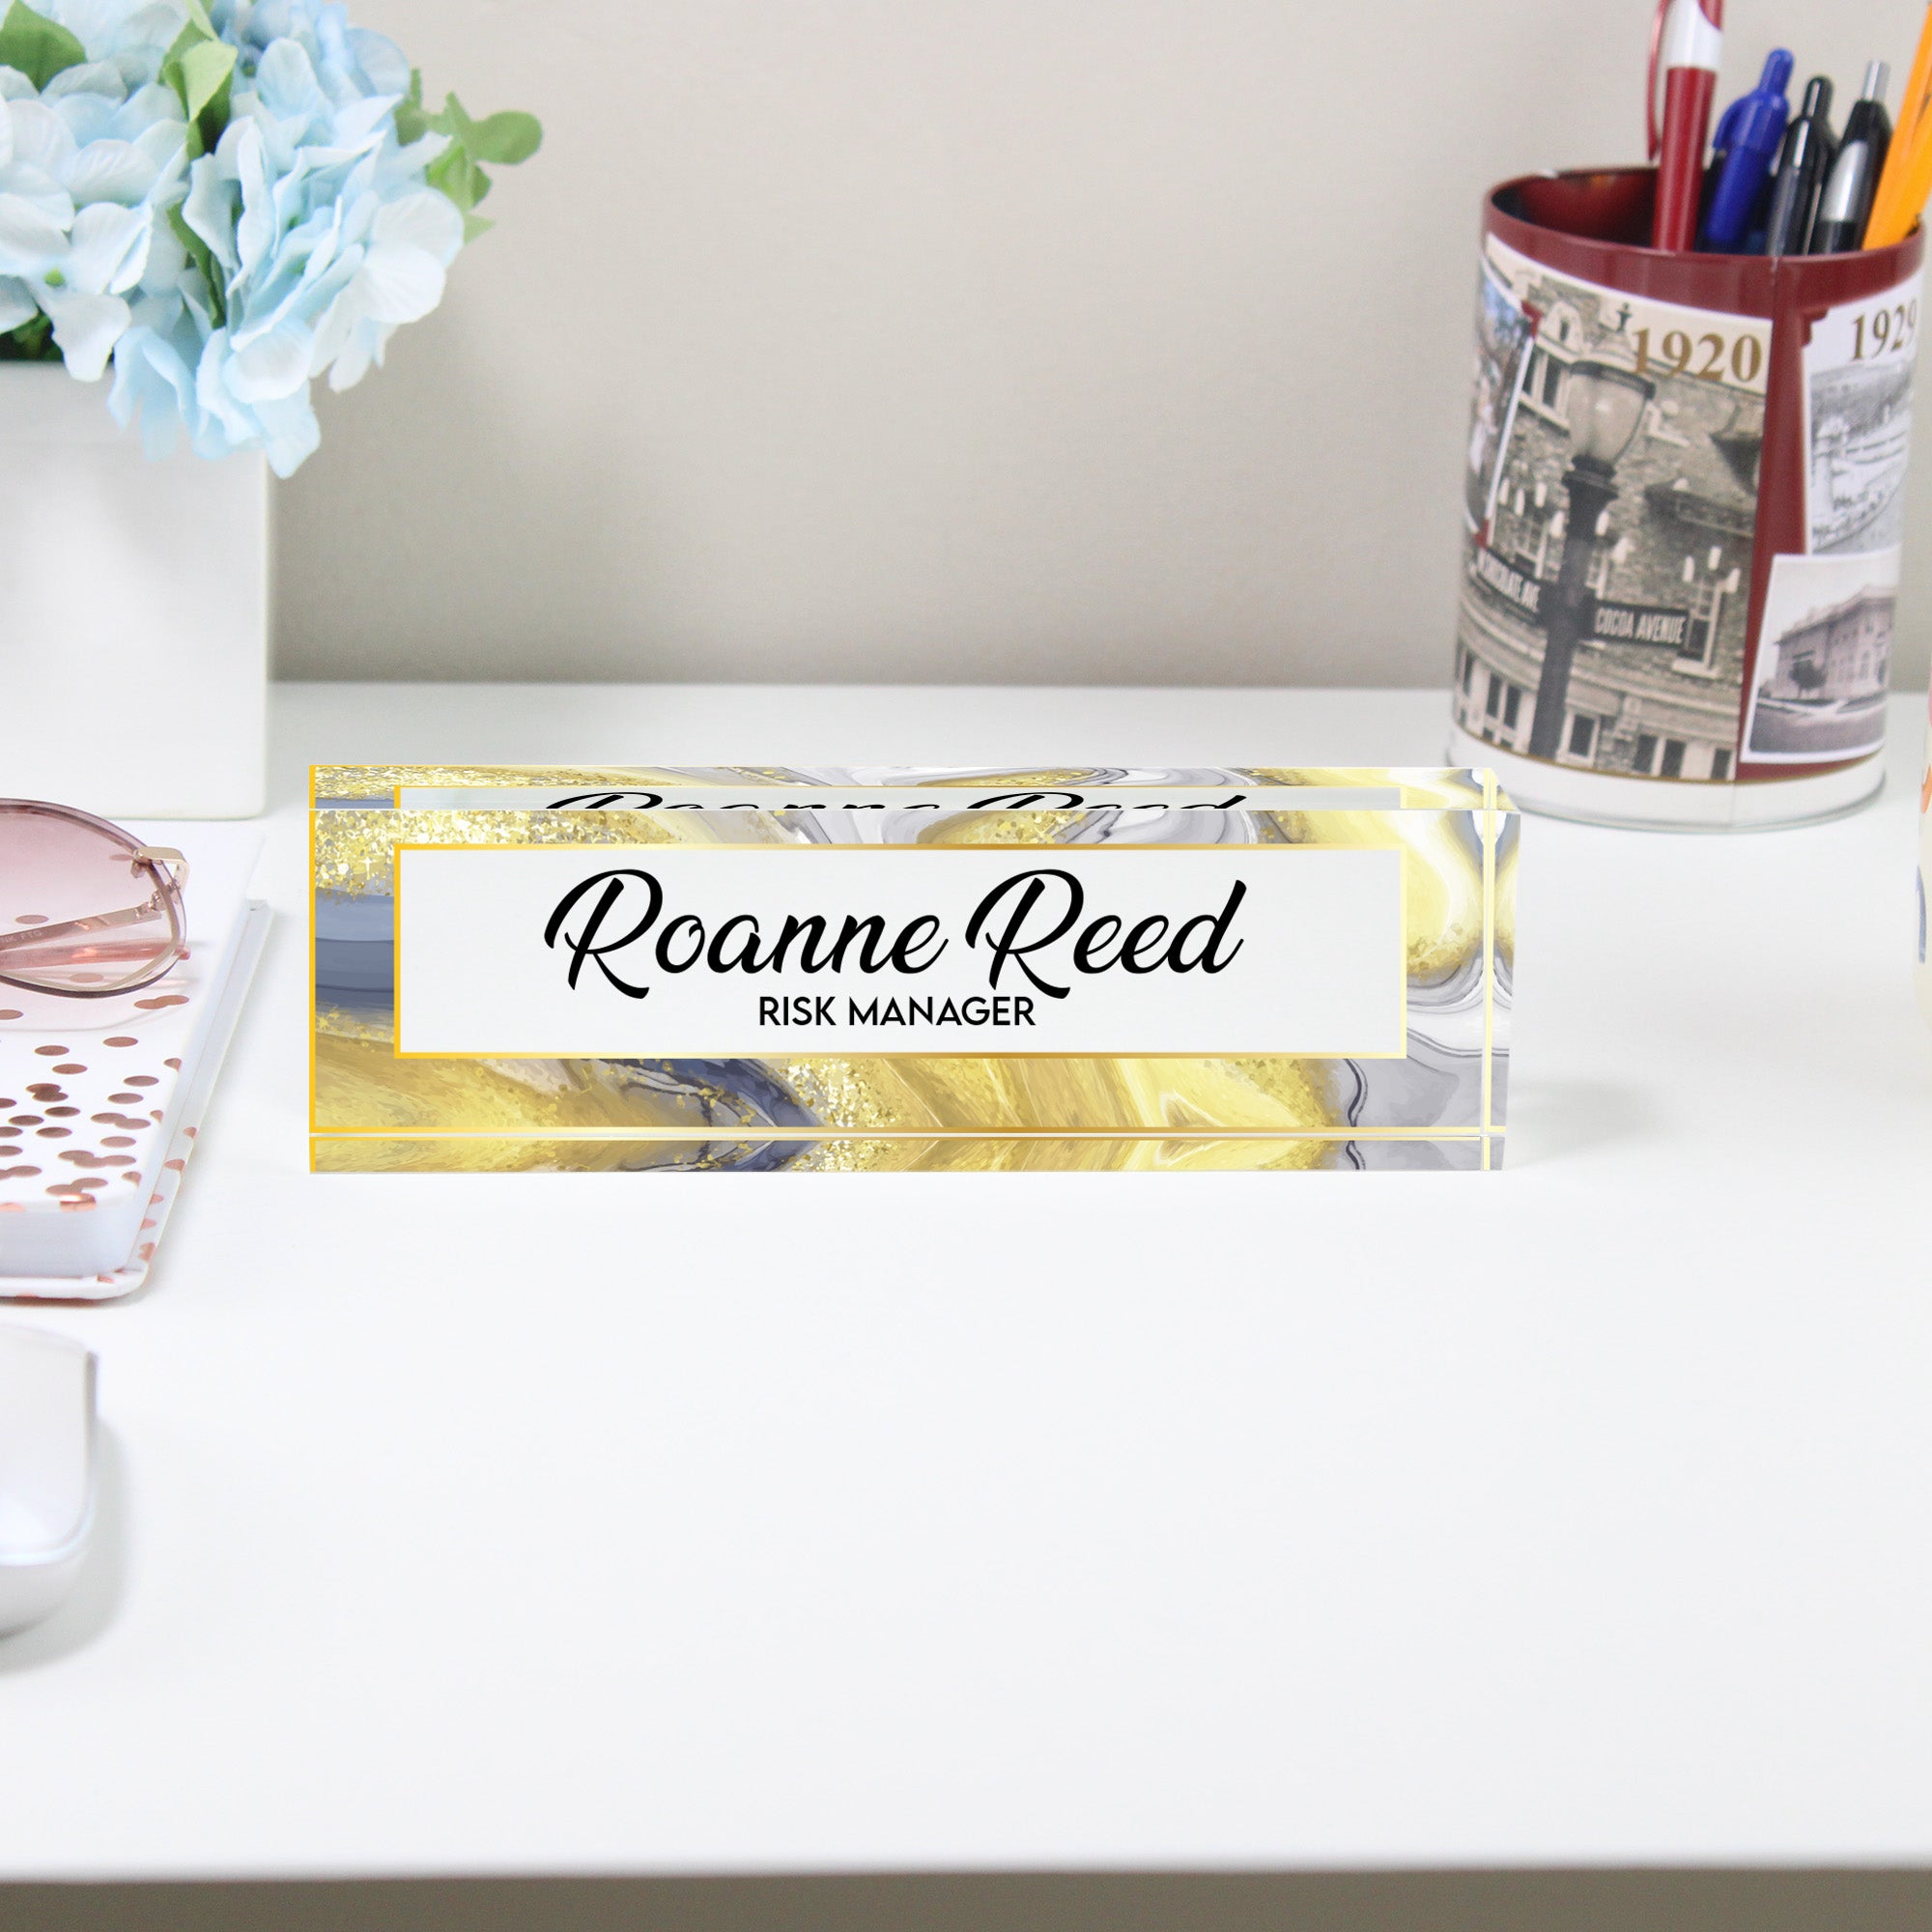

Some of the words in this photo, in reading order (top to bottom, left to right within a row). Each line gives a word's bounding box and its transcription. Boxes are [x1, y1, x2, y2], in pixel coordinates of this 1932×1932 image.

[1632, 327, 1762, 384] 1920
[1851, 298, 1918, 360] 1929
[1594, 607, 1634, 639] COCOA
[1635, 612, 1687, 644] AVENUE
[544, 868, 950, 1000] Roanne
[965, 868, 1247, 1000] Reed
[759, 996, 838, 1026] RISK
[849, 996, 1037, 1026] MANAGER
